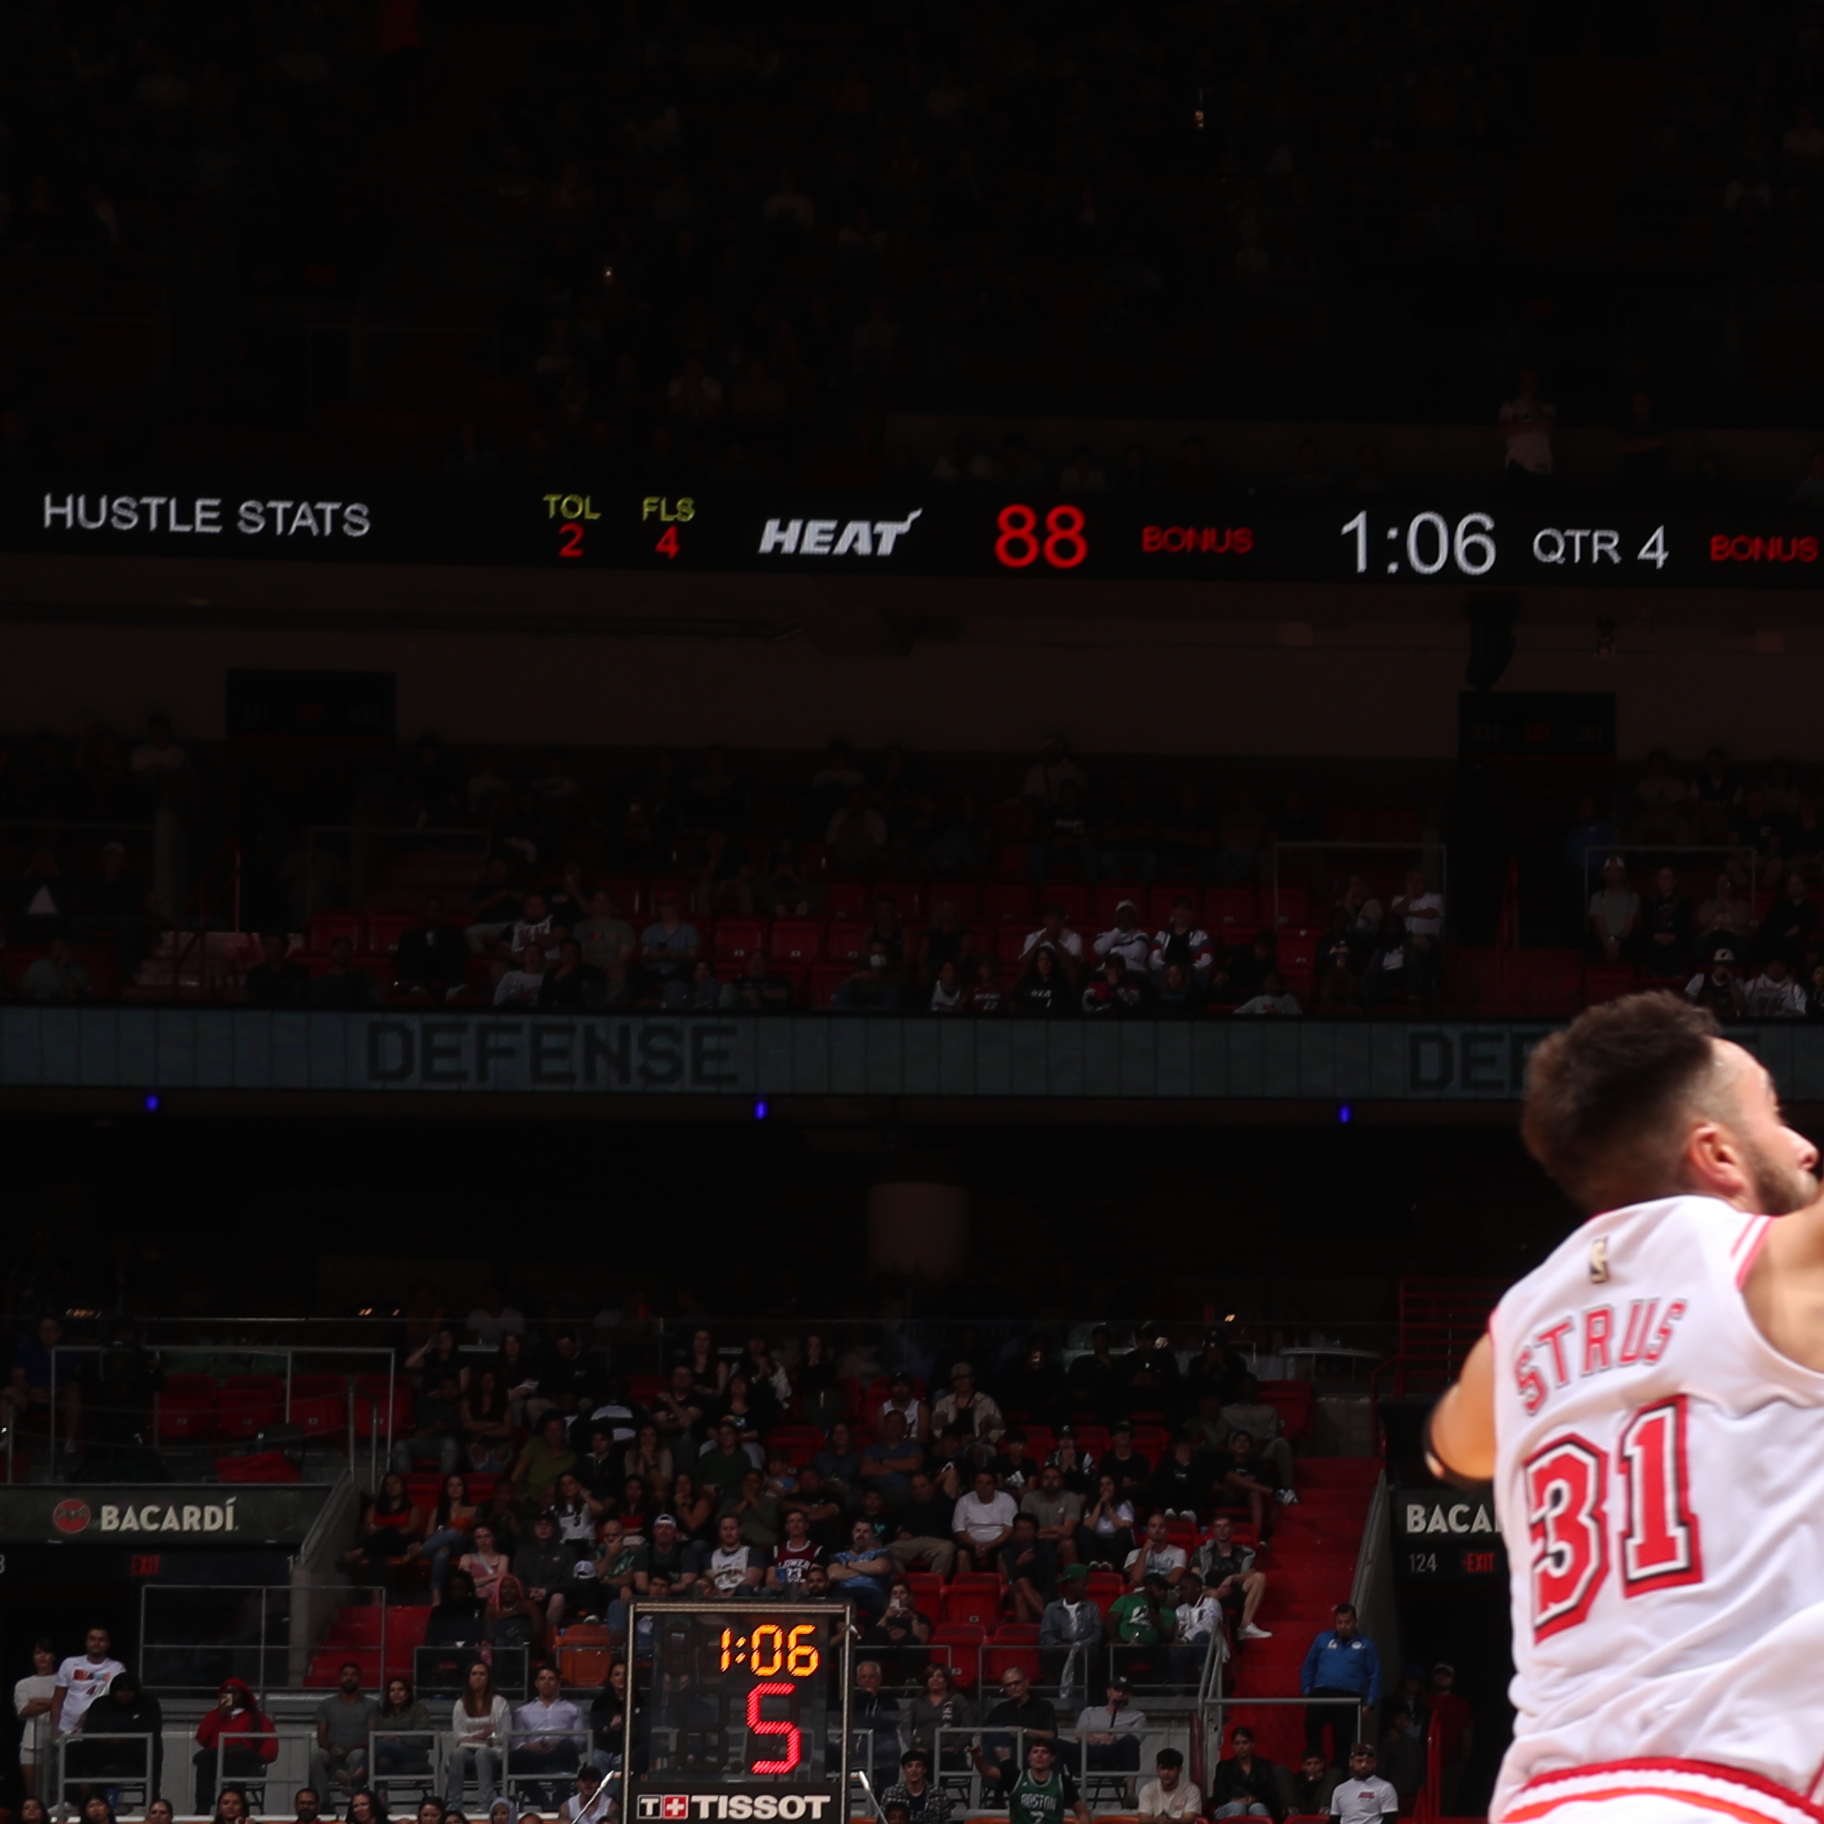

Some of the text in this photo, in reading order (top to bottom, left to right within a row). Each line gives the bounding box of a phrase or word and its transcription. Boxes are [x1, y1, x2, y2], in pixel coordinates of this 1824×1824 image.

[44, 493, 371, 538] HUSTLE STATS
[543, 494, 601, 520] TOL
[642, 496, 696, 522] FLS
[559, 524, 584, 558] 2
[655, 525, 680, 559] 4
[758, 508, 923, 556] HEAT
[994, 503, 1088, 569] 88
[1141, 525, 1253, 554] BONUS
[1341, 510, 1497, 576] 1:06
[1532, 528, 1622, 565] QTR
[1637, 525, 1669, 569] 4
[1709, 534, 1819, 563] BONUS
[366, 1020, 739, 1087] DEFENSE
[1515, 1298, 1688, 1415] STRUS
[99, 1497, 234, 1533] BACARDÍ
[1525, 1394, 1702, 1644] 31
[130, 1555, 161, 1576] EXIT
[1408, 1552, 1495, 1576] 124 EXIT
[718, 1622, 820, 1679] 1:06
[745, 1682, 804, 1775] 5
[691, 1794, 832, 1821] TISSOT
